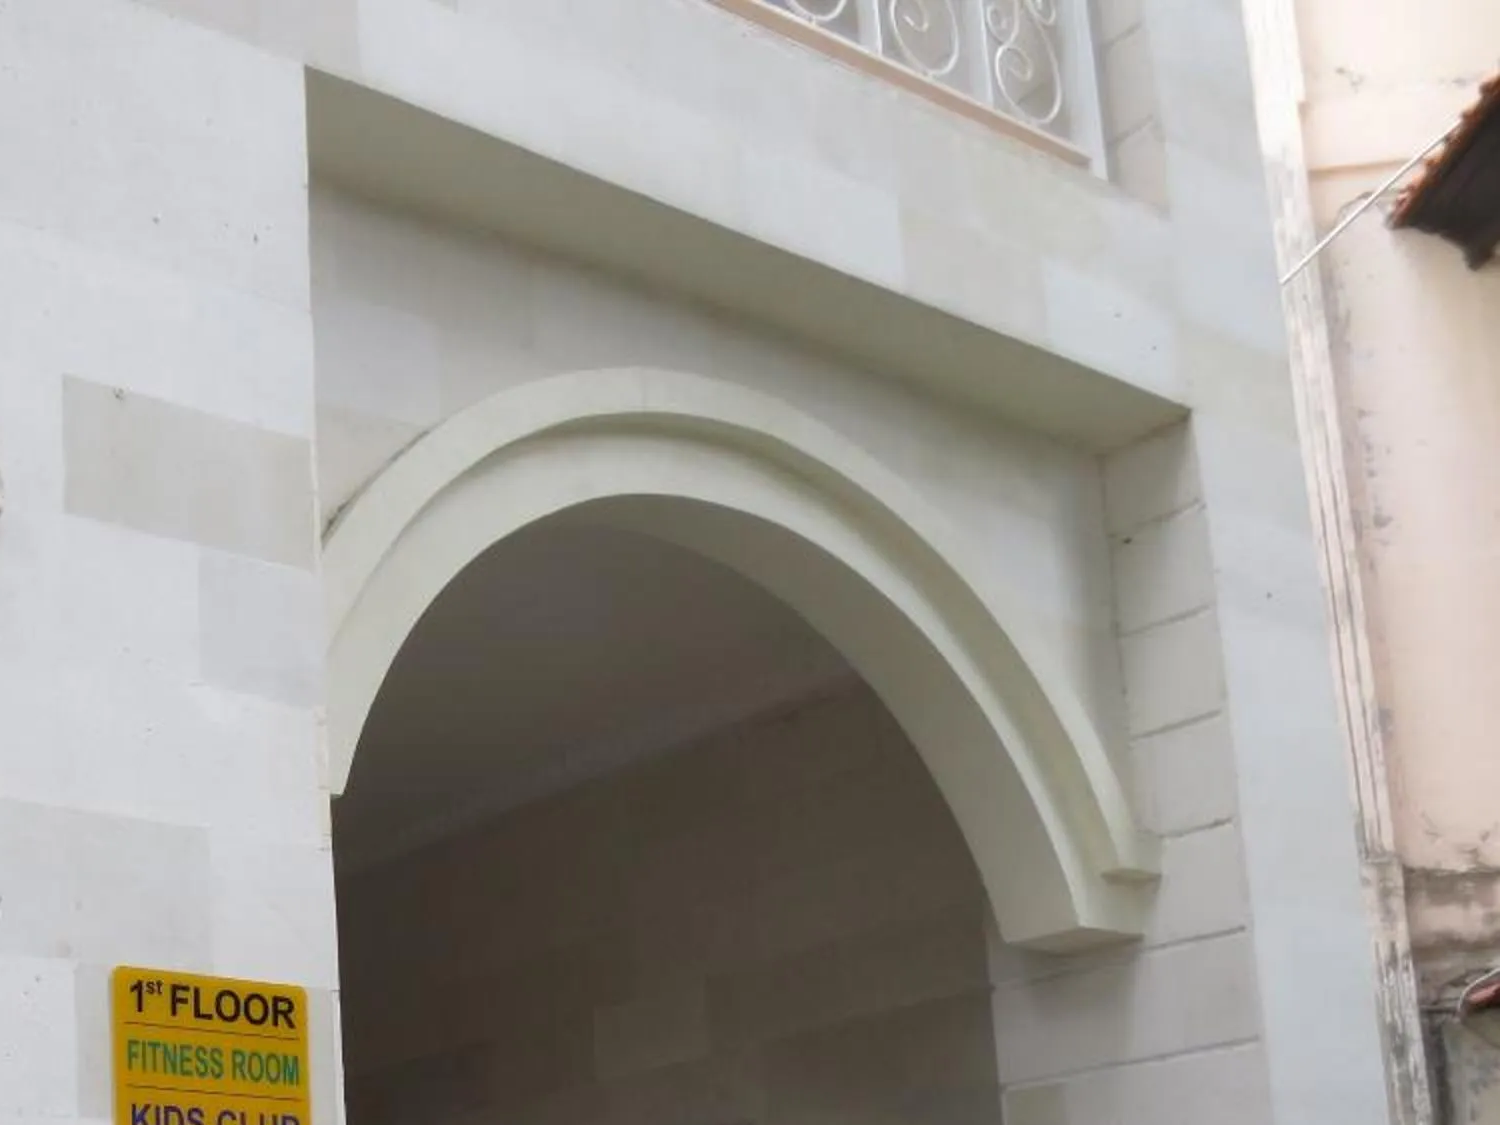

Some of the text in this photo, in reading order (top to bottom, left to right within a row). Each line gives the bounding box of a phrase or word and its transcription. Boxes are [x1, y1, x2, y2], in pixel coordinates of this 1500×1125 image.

[171, 985, 296, 1029] FLOOR
[127, 1039, 300, 1086] FITNESS ROOM
